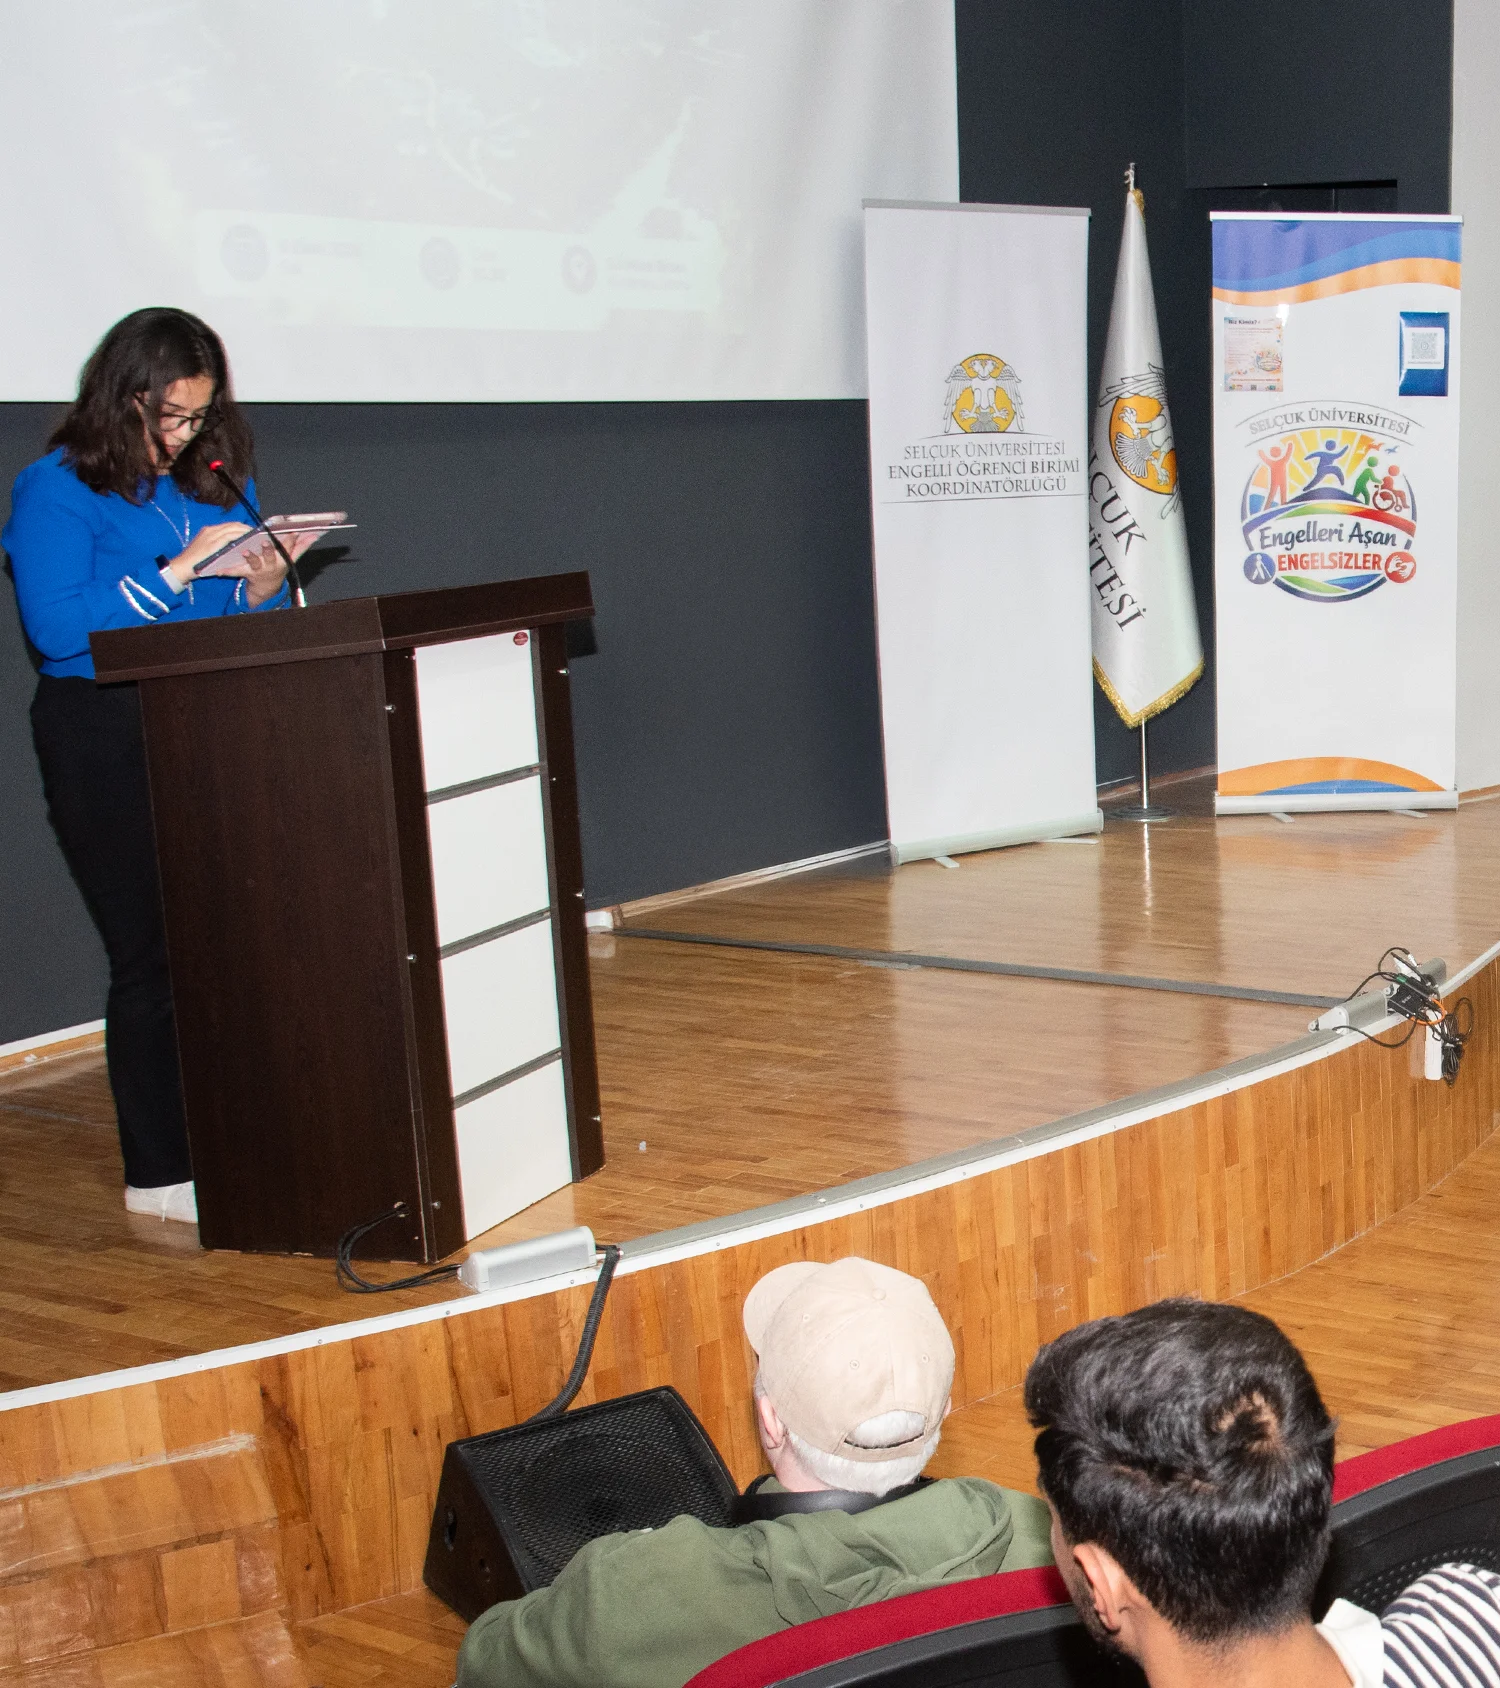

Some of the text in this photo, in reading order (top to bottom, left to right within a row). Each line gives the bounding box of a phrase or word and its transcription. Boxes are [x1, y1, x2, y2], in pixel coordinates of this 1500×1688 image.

[1250, 408, 1411, 435] SELÇUK ÜNİVERSİTESİ
[904, 440, 1065, 461] SELÇUK ÜNİVERSİTESİ
[889, 458, 1080, 479] ENGELLİ ÖĞRENCİ BİRİMİ
[906, 476, 1066, 497] KOORDİNATÖRLÜĞÜ
[1259, 521, 1397, 550] Engelleri Aşan
[1278, 551, 1382, 571] ENGELSİZLER
